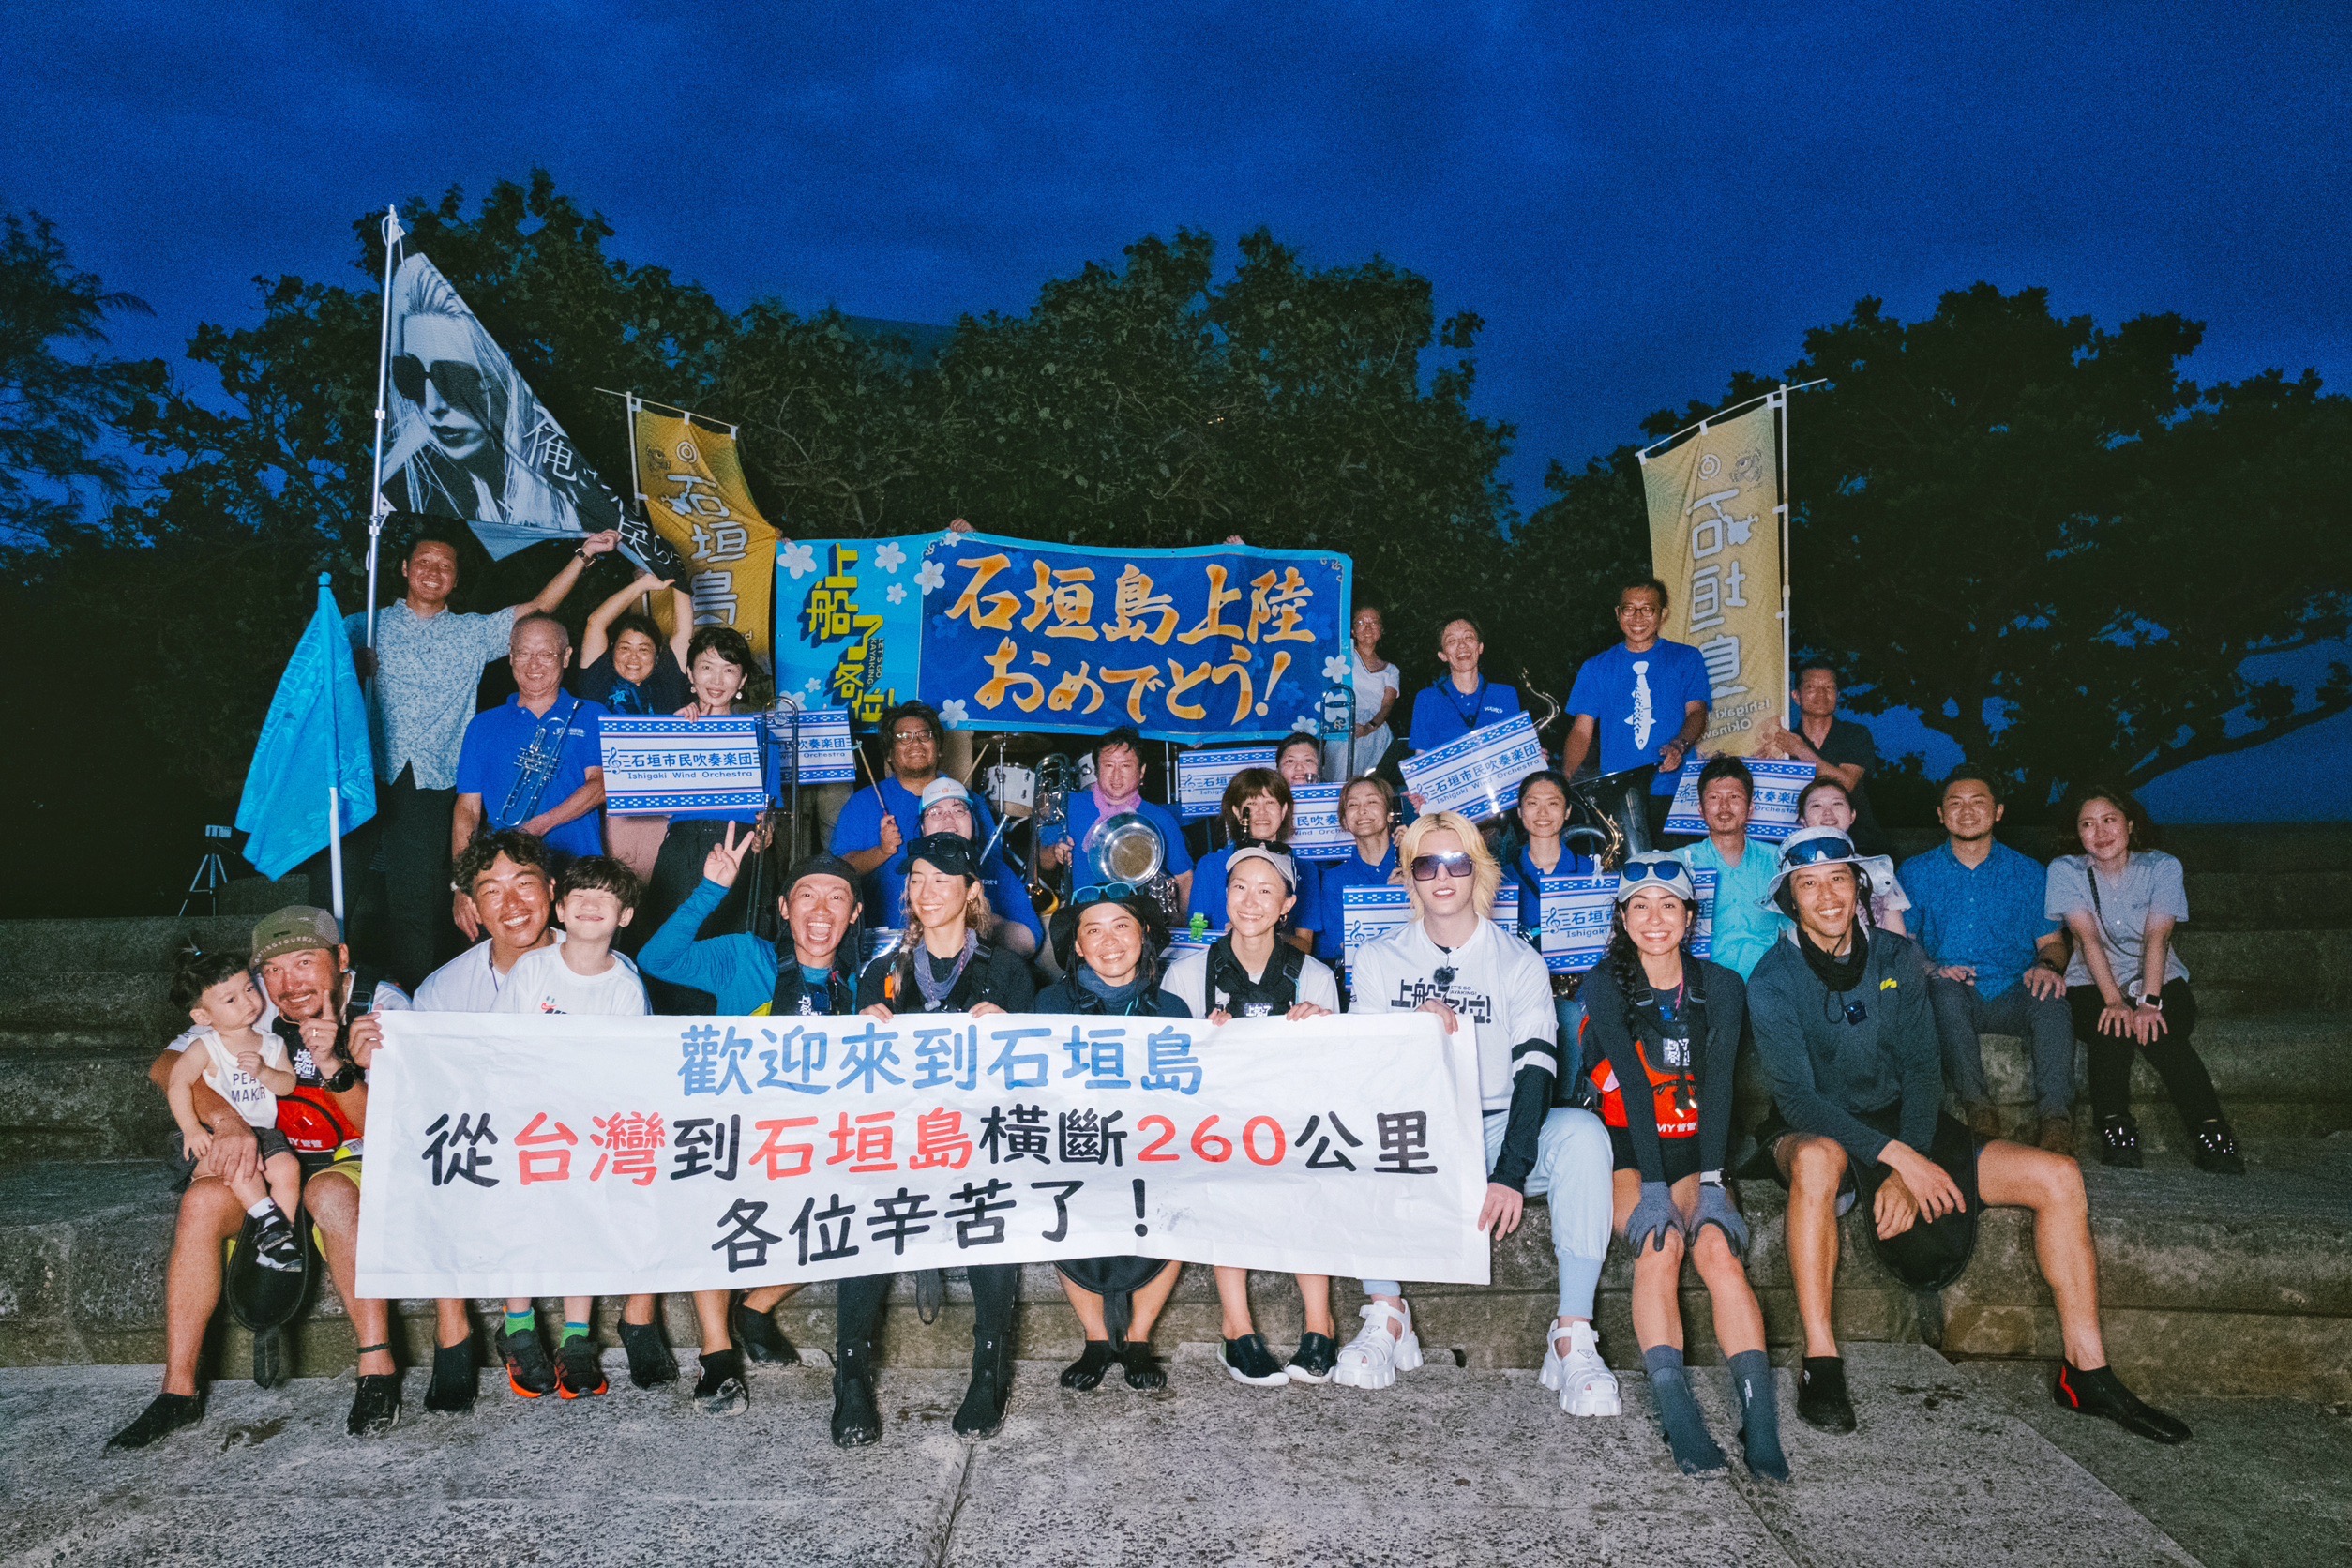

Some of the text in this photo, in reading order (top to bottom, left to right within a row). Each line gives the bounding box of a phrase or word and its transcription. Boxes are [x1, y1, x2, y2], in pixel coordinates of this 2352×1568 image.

[945, 553, 1316, 646] 石垣島上陸
[876, 664, 882, 678] GO
[973, 636, 1292, 726] おめでとう!
[627, 769, 752, 781] Ishigaki Wind Orchestra
[631, 751, 752, 768] 石垣市民吹奏楽団
[1203, 776, 1230, 787] 石垣
[1436, 742, 1537, 792] 石垣市民吹奏楽団
[1436, 788, 1469, 804] Ishigaki
[1497, 759, 1540, 778] Orchestra
[1566, 927, 1608, 938] Ishigaki
[678, 1023, 1202, 1096] 歡迎來到石垣島
[422, 1104, 1439, 1188] 從台灣到石垣島橫斷260公里
